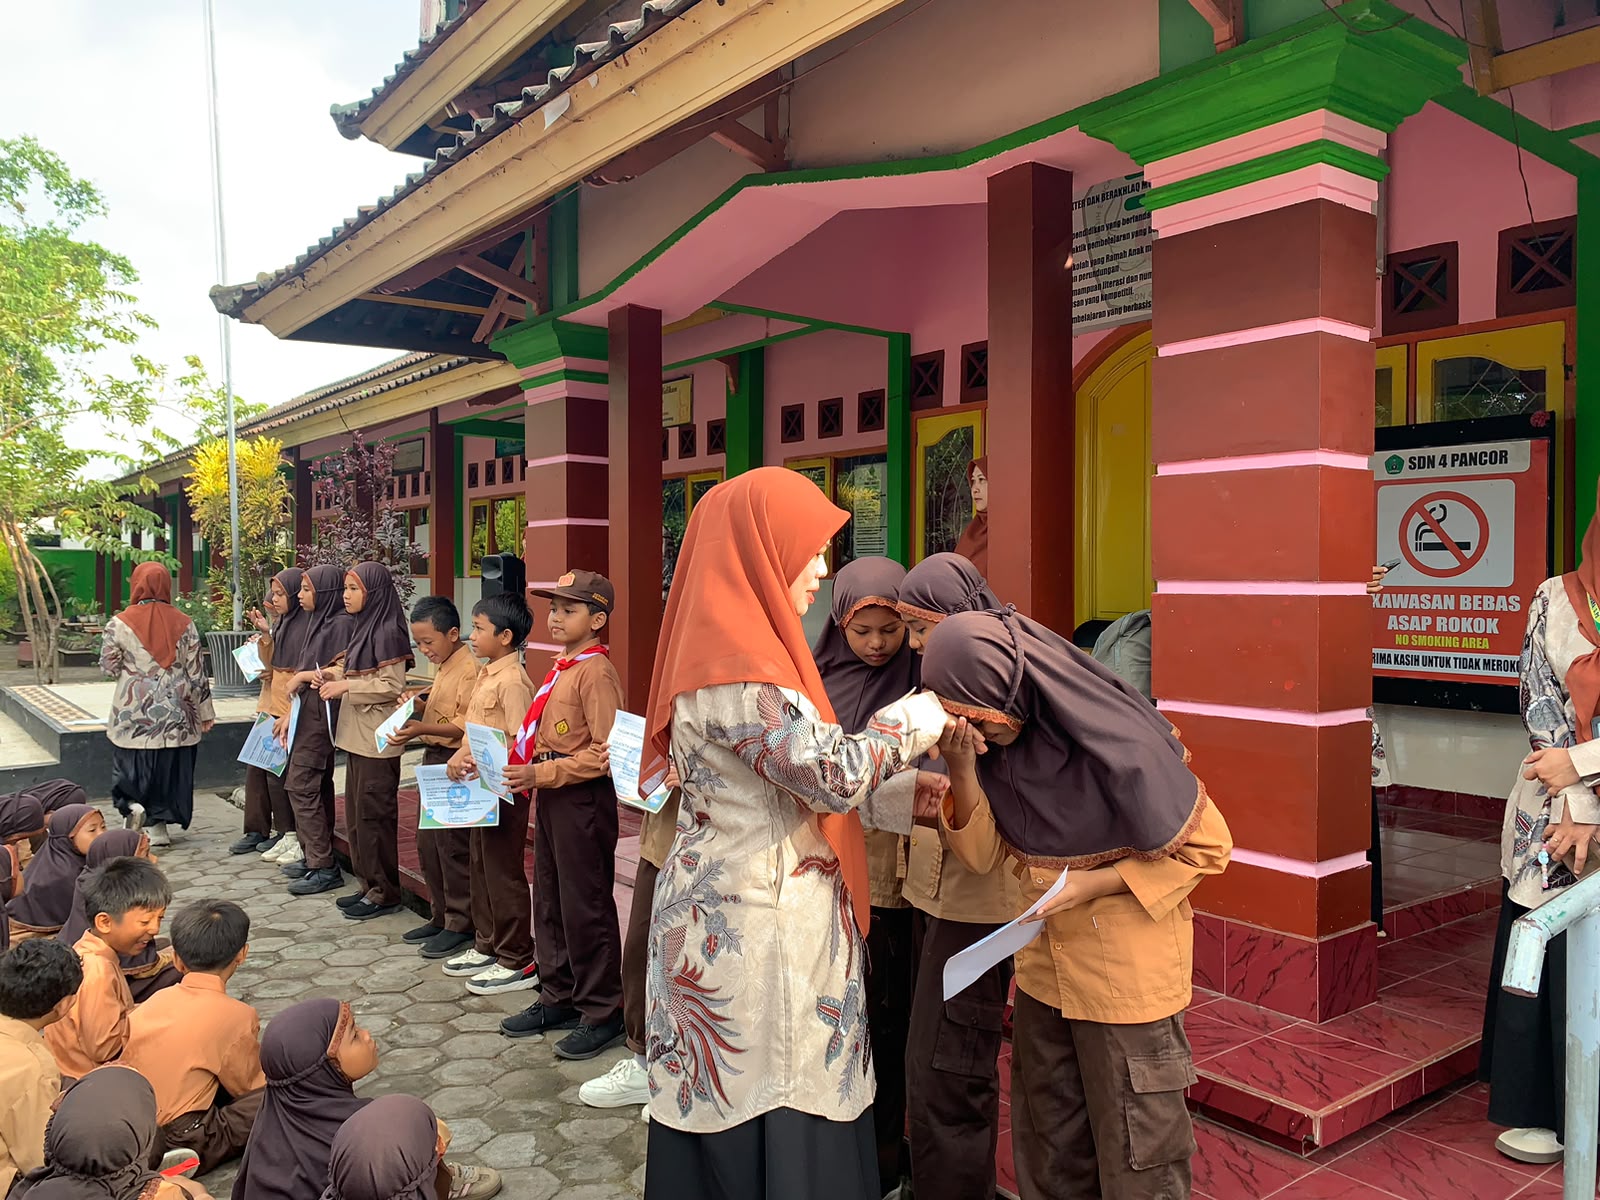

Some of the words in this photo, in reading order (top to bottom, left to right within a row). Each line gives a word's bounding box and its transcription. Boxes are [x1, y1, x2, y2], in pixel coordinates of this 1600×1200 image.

[1087, 194, 1100, 206] DAN
[1101, 181, 1140, 202] BERAKHLAQ
[1105, 219, 1121, 231] yang
[1087, 233, 1131, 251] pembelajaran
[1131, 228, 1147, 239] yang
[1089, 256, 1105, 268] yang
[1105, 250, 1127, 263] Ramah
[1128, 246, 1144, 257] Anak
[1078, 264, 1120, 282] perundungan
[1102, 276, 1125, 290] literasi
[1126, 274, 1138, 284] dan
[1084, 295, 1100, 306] yang
[1107, 305, 1122, 317] yang
[1122, 300, 1152, 313] berbasis
[1408, 455, 1436, 471] SDN
[1438, 454, 1448, 469] 4
[1451, 450, 1508, 468] PANCOR
[1459, 595, 1521, 612] BEBAS
[1387, 615, 1432, 631] ASAP
[1436, 616, 1500, 635] ROKOK
[1395, 634, 1409, 646] NO
[1411, 635, 1460, 648] SMOKING
[1461, 637, 1490, 650] AREA
[1393, 653, 1420, 667] KASIH
[1421, 655, 1451, 669] UNTUK
[1453, 657, 1481, 671] TIDAK
